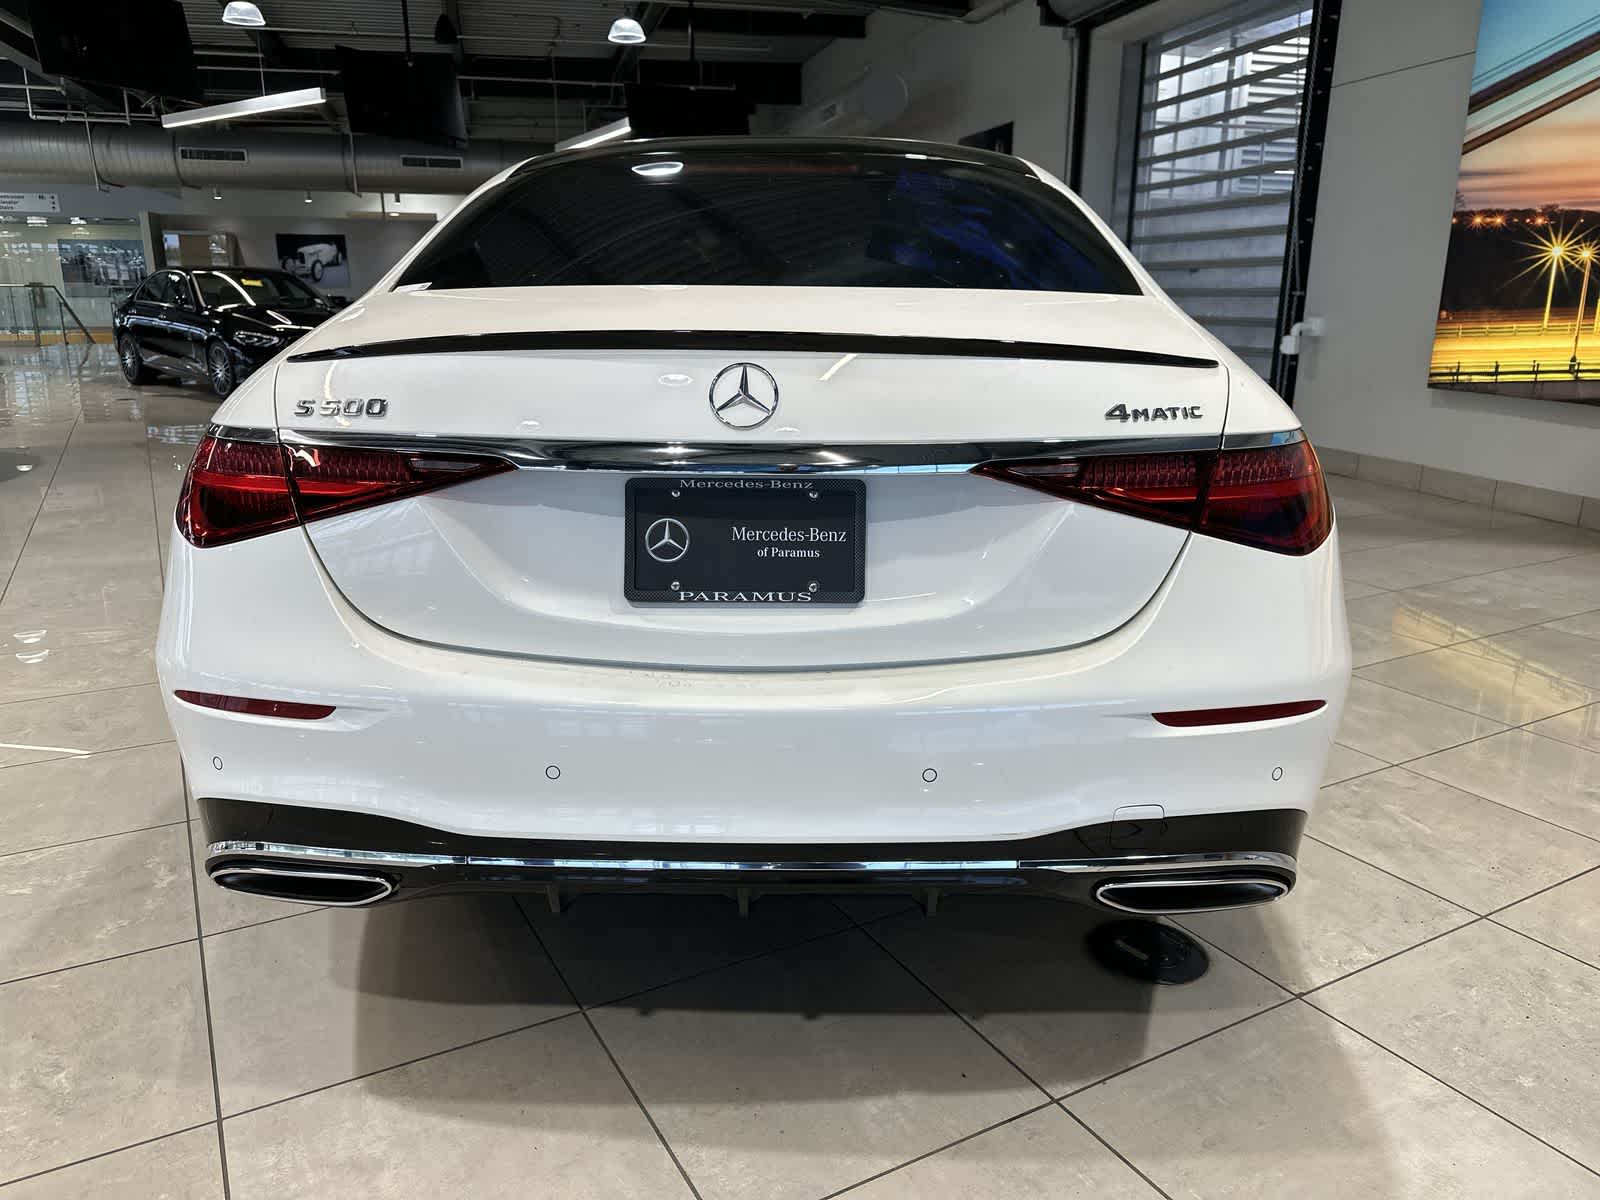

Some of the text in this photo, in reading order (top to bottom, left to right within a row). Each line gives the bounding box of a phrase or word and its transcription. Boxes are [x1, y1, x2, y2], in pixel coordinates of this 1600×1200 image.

[294, 398, 389, 418] S 500
[1104, 403, 1204, 422] 4MATIC
[679, 479, 814, 489] Mercedes-Benz
[731, 526, 847, 543] Mercedes-Benz
[757, 547, 820, 559] of Paramus
[679, 591, 812, 602] PARAMUS
